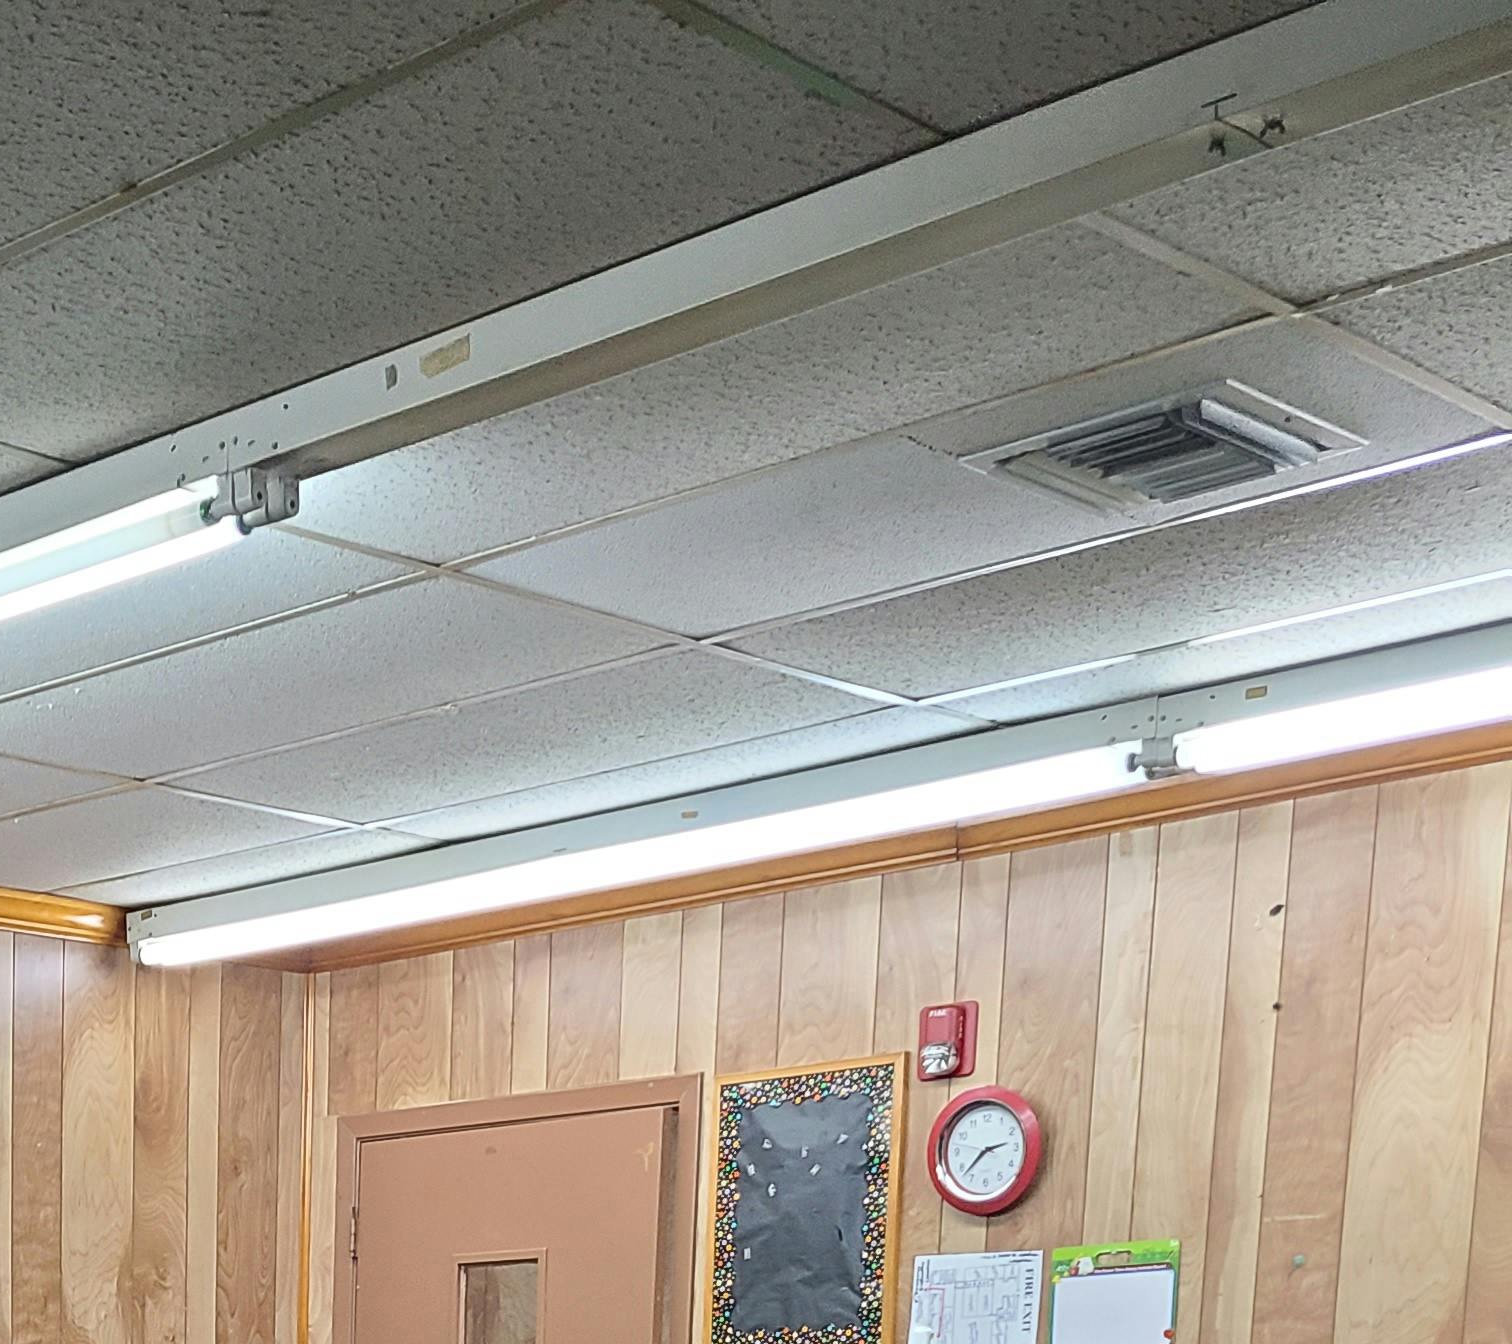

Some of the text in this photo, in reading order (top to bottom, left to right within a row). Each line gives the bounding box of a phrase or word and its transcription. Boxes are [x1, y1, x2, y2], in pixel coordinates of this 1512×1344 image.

[984, 1113, 992, 1122] 12
[970, 1120, 976, 1128] 11
[958, 1132, 968, 1140] 10
[1009, 1127, 1016, 1136] 2
[1014, 1142, 1019, 1152] 3
[954, 1148, 960, 1157] 9
[969, 1174, 974, 1182] 7
[997, 1172, 1003, 1181] 5
[983, 1178, 988, 1187] 6
[1022, 1269, 1034, 1334] FIRE EXIT
